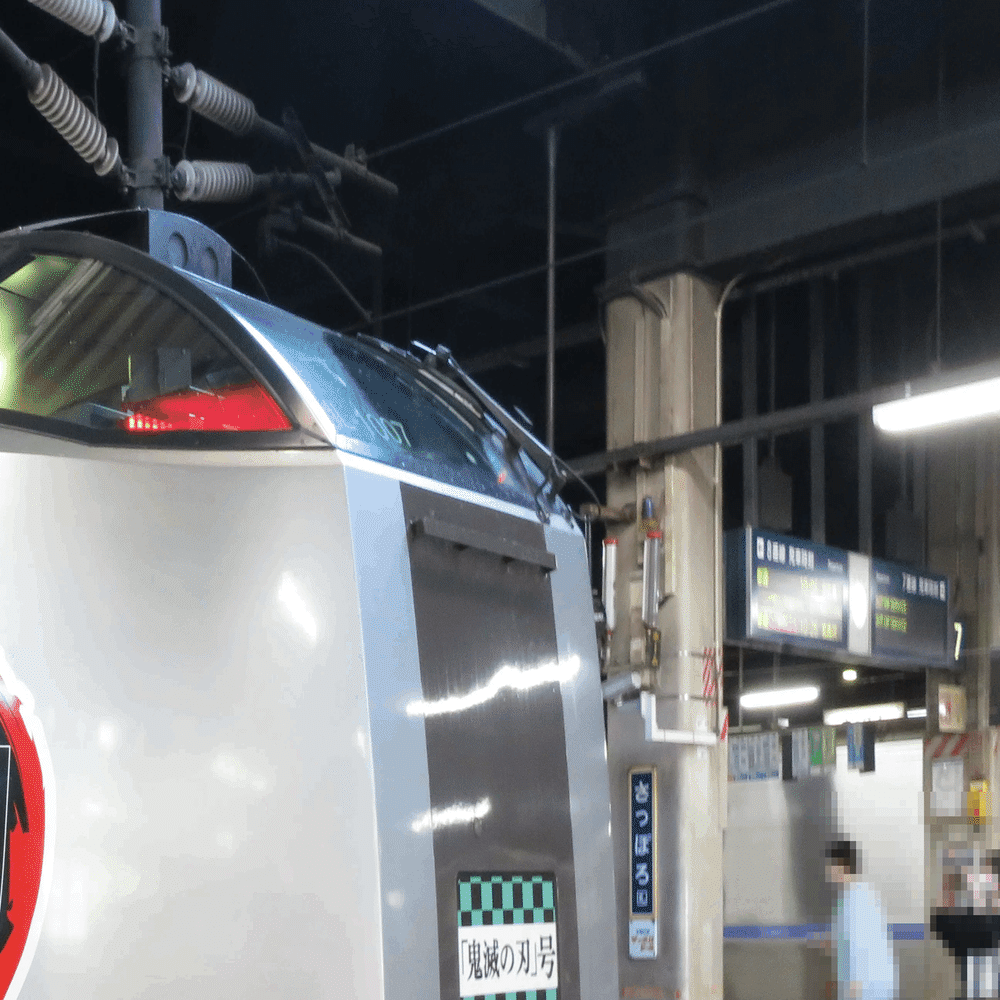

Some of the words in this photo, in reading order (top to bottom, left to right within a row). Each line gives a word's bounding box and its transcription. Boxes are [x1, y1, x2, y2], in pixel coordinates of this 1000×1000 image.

[461, 934, 556, 980] 「鬼滅の刃」号
